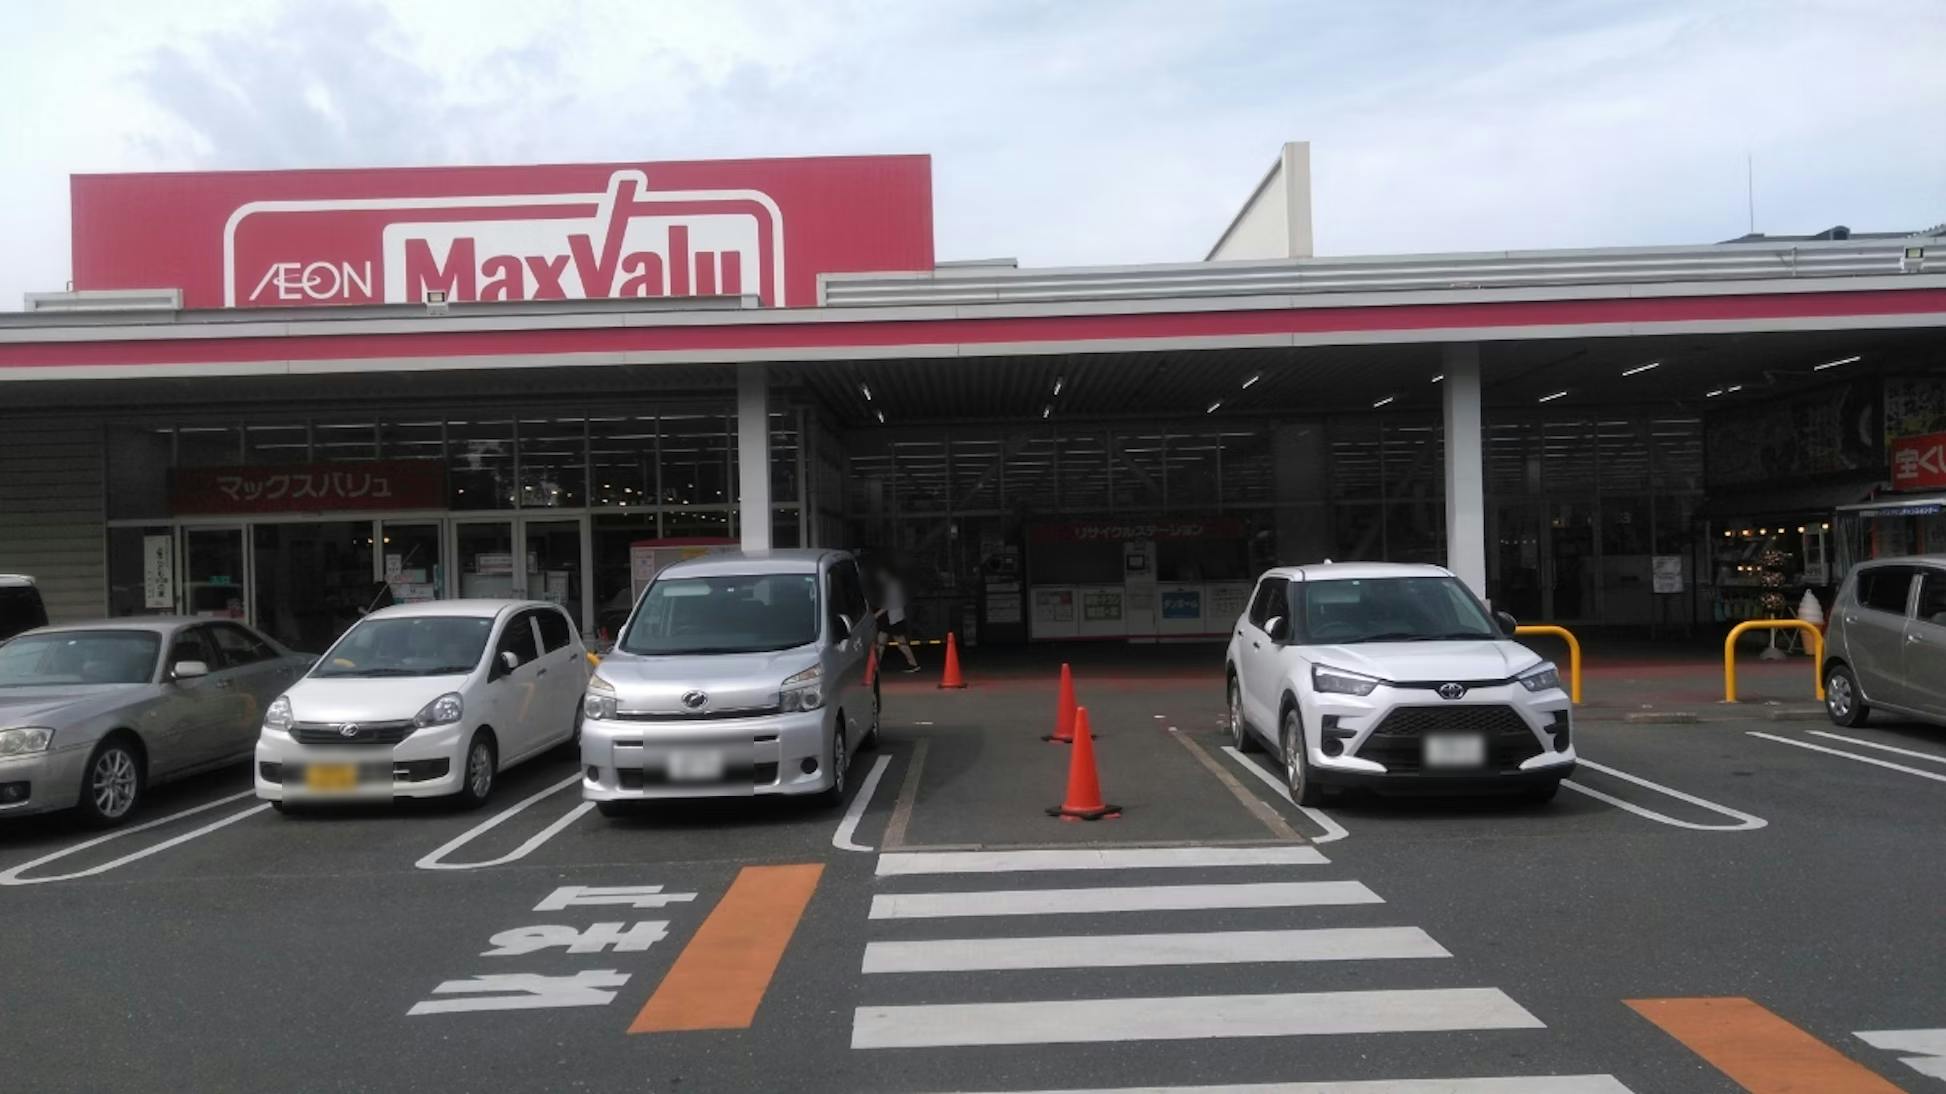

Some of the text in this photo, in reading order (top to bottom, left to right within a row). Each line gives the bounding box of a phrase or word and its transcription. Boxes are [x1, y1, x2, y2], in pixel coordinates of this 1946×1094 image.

[404, 179, 741, 304] MaxValu
[216, 471, 393, 502] マックスバリュ
[1074, 523, 1203, 539] リサイクルステーション
[406, 885, 698, 1015] 止まれ
